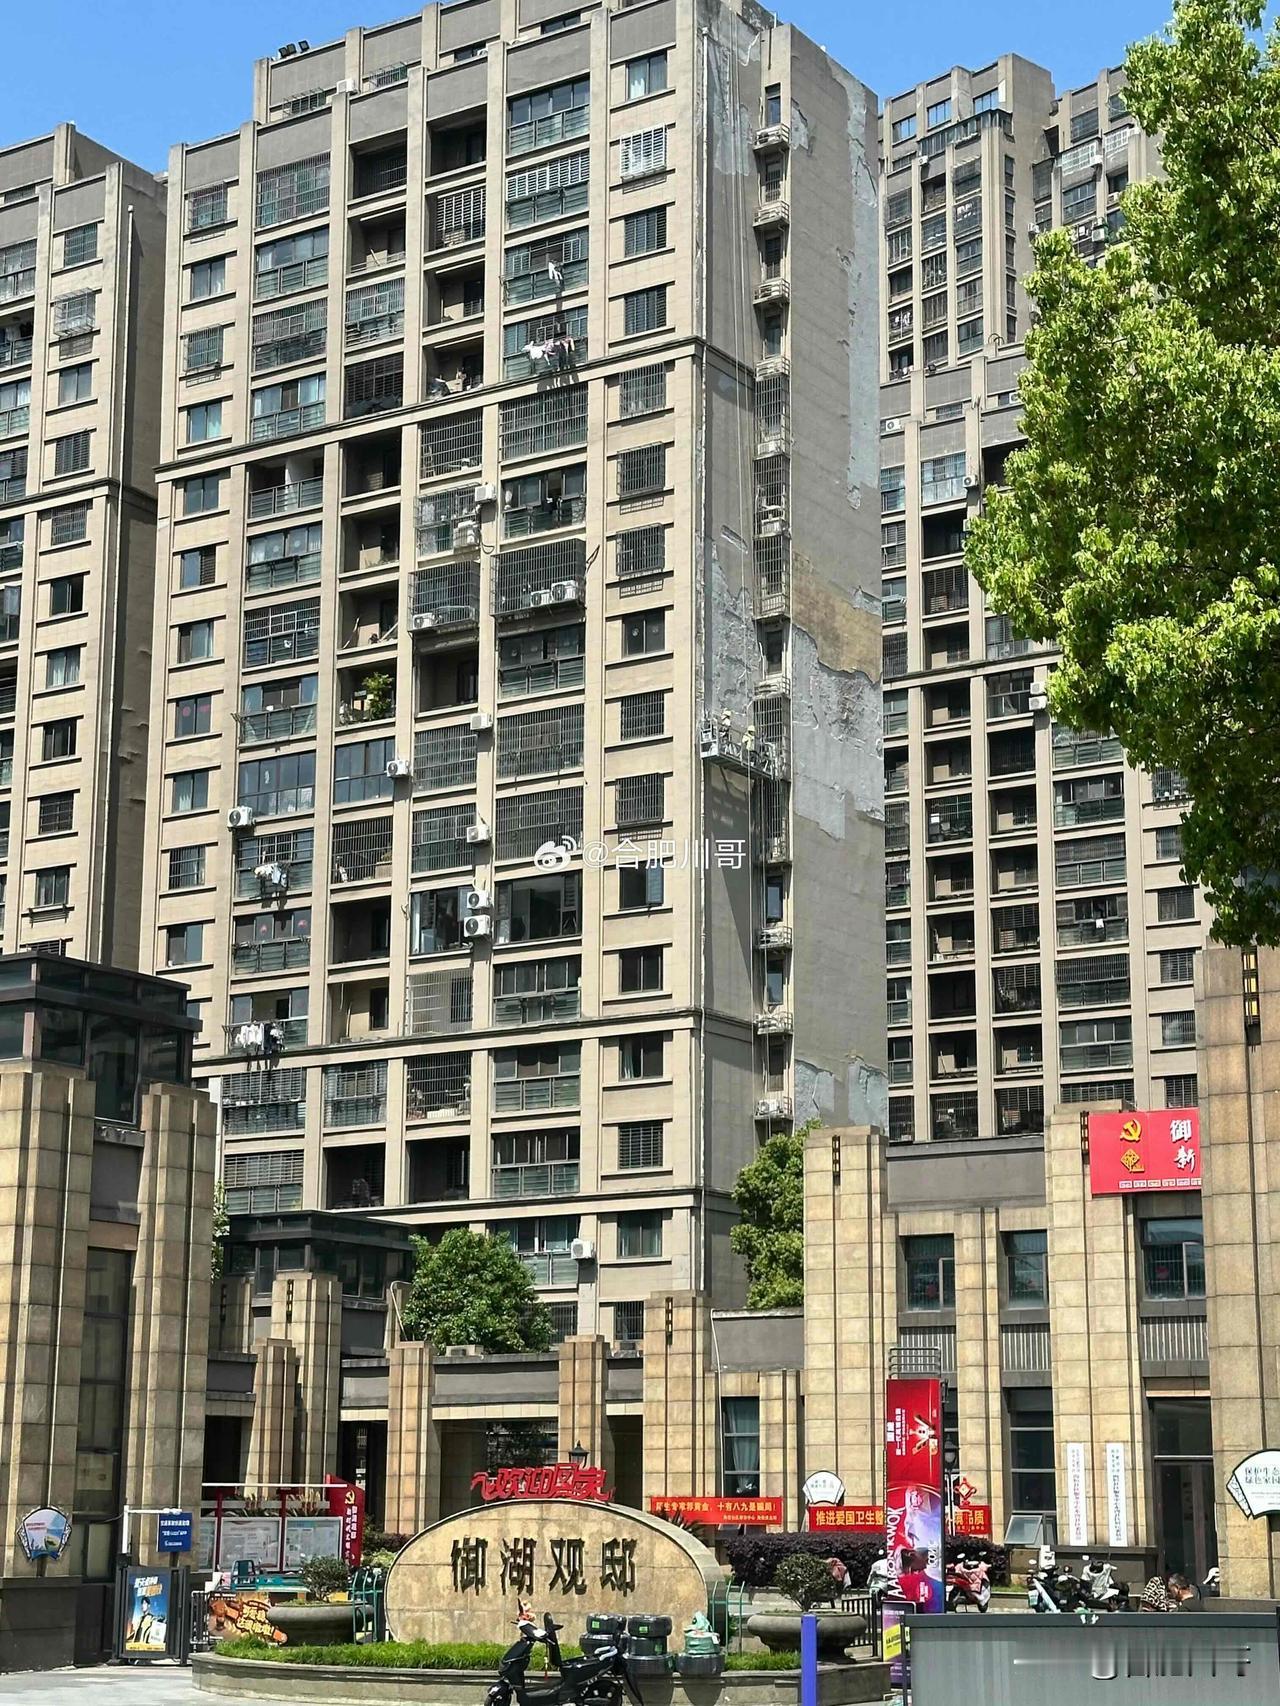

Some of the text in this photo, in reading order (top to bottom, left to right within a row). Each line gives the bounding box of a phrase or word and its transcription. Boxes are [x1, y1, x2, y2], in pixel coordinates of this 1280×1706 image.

[1169, 1119, 1192, 1142] 御
[1173, 1145, 1195, 1173] 新
[473, 1463, 615, 1501] 欢迎回家
[887, 1506, 905, 1545] KWOK
[450, 1538, 638, 1596] 御湖观邸
[887, 1549, 906, 1598] AARON
